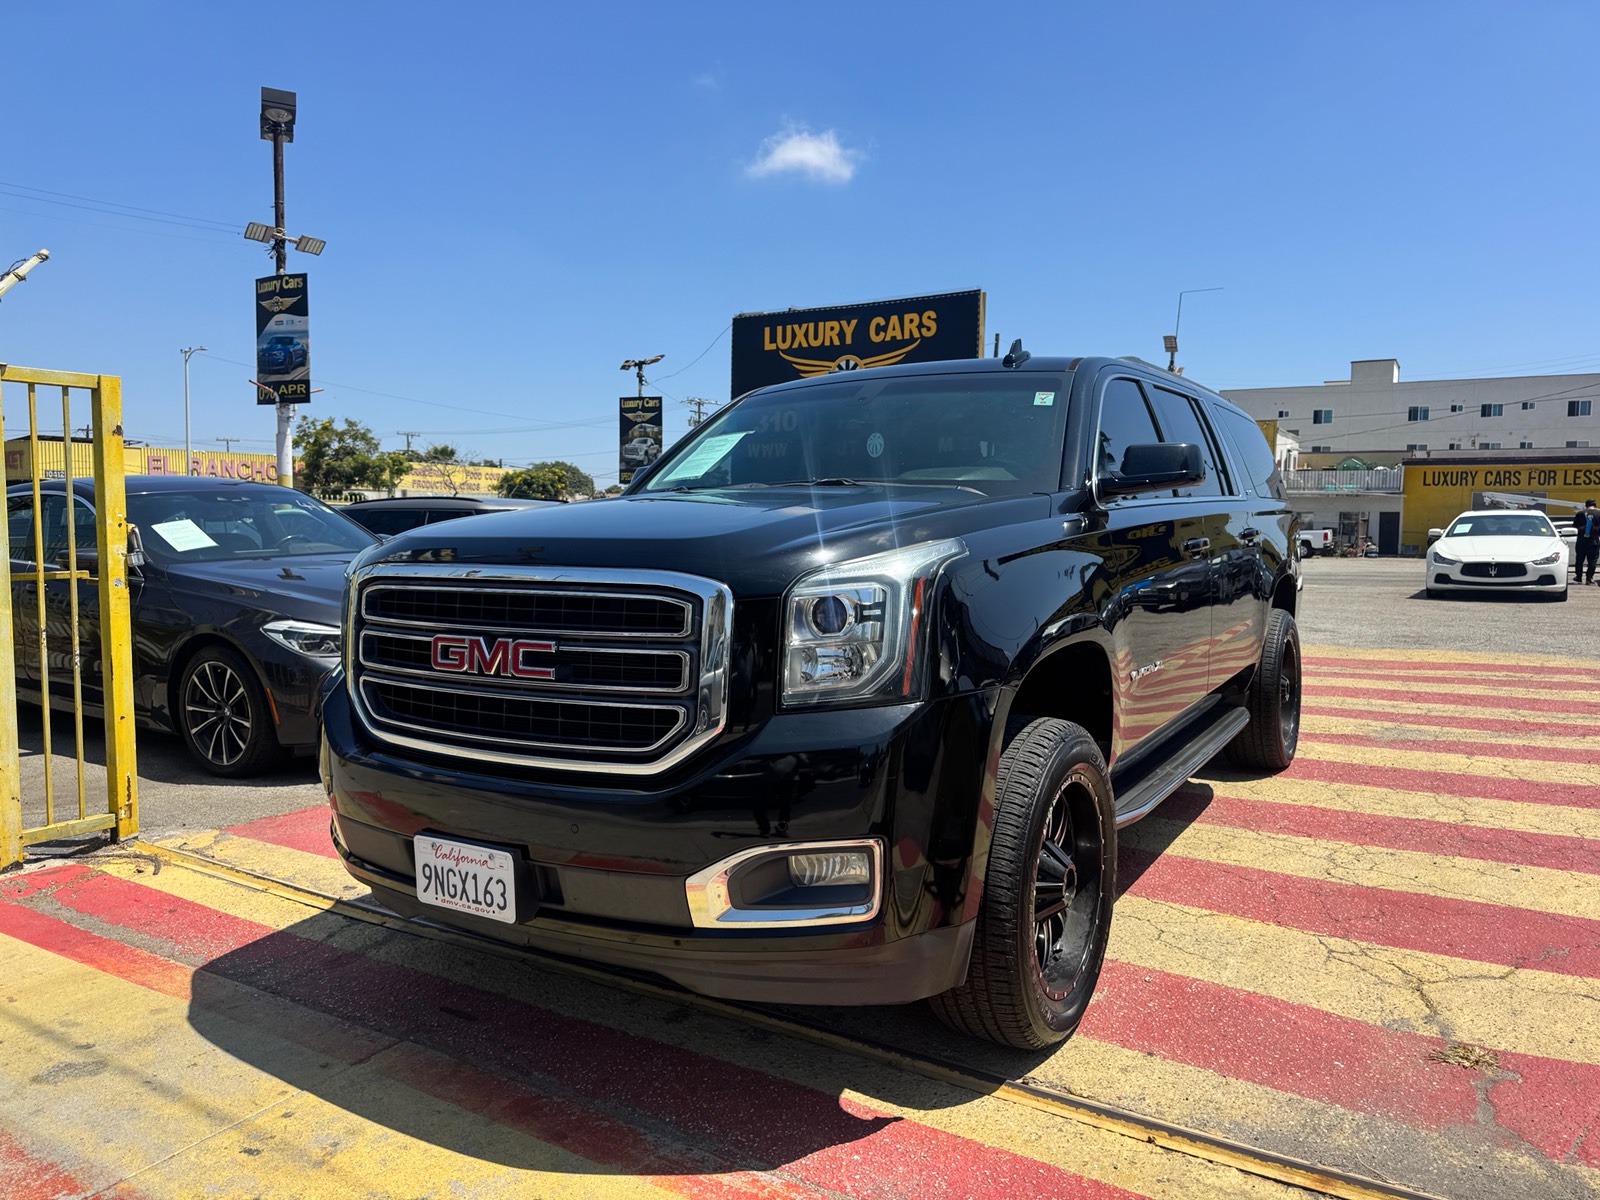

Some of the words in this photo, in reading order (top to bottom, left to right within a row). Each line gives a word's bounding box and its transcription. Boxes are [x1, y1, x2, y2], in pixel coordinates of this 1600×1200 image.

[257, 279, 281, 294] Luxury
[282, 276, 304, 289] Cars
[763, 319, 858, 351] LUXURY
[869, 310, 937, 343] CARS
[279, 384, 306, 394] APR
[621, 399, 643, 409] Luxury
[643, 398, 660, 408] Cars
[147, 455, 177, 476] EL
[189, 457, 278, 480] RANCHO
[465, 470, 482, 480] FOOD
[1423, 471, 1478, 486] LUXURY
[1484, 470, 1521, 486] CARS
[1528, 469, 1557, 486] FOR
[1563, 469, 1600, 486] LESS
[431, 634, 556, 680] GMC
[434, 844, 495, 870] California
[422, 863, 507, 911] 9NGX163
[441, 898, 490, 914] dmv.ca.gov
